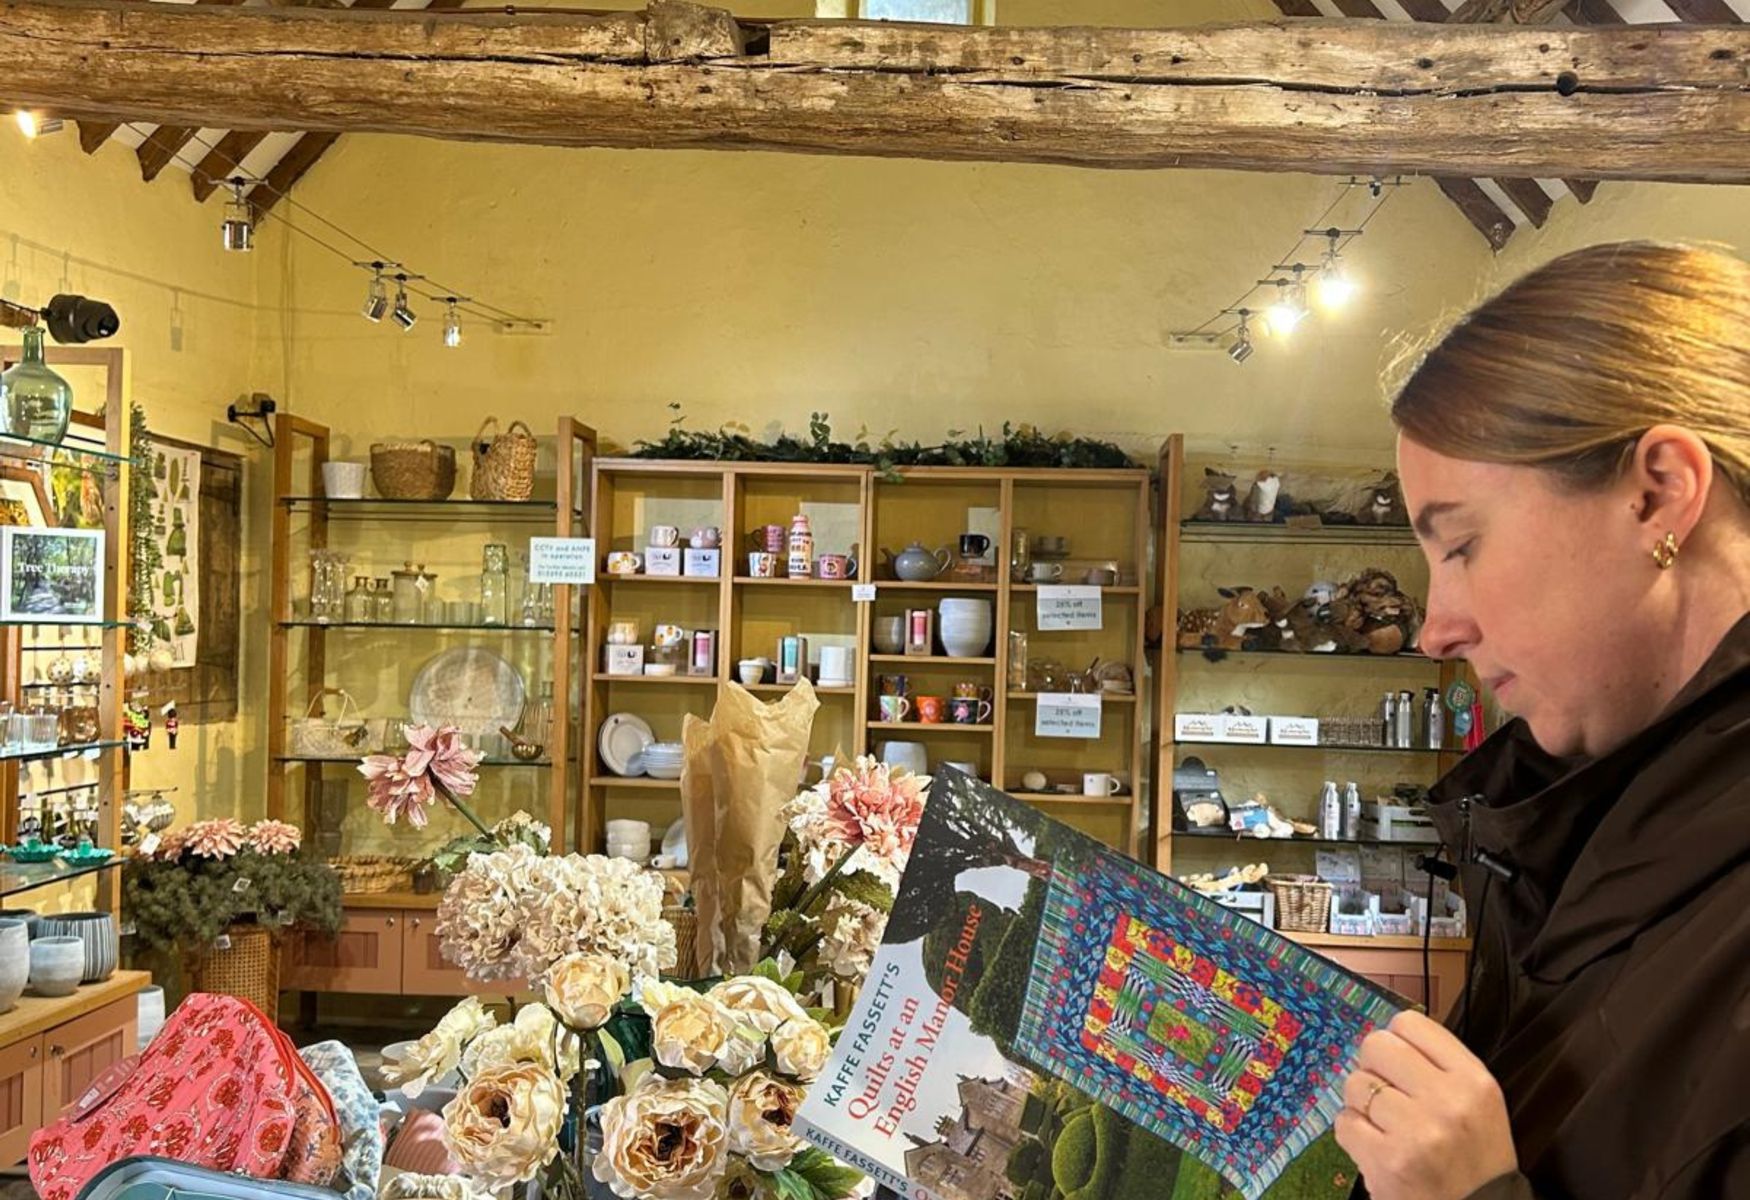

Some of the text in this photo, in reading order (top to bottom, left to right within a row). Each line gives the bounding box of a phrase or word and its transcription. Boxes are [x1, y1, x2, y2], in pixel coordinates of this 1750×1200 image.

[534, 543, 554, 552] CCTV
[18, 562, 89, 577] Tree Therapy
[1072, 600, 1083, 608] off
[1042, 611, 1096, 619] selected items
[1072, 708, 1082, 716] off
[1041, 719, 1095, 728] selected items
[873, 1054, 928, 1139] English
[915, 975, 958, 1053] Manor
[945, 903, 982, 974] House
[824, 962, 900, 1107] KAFFE FASSETT'S
[848, 996, 920, 1120] Quilts at an
[805, 1128, 909, 1192] KAFFE FASSETT'S
